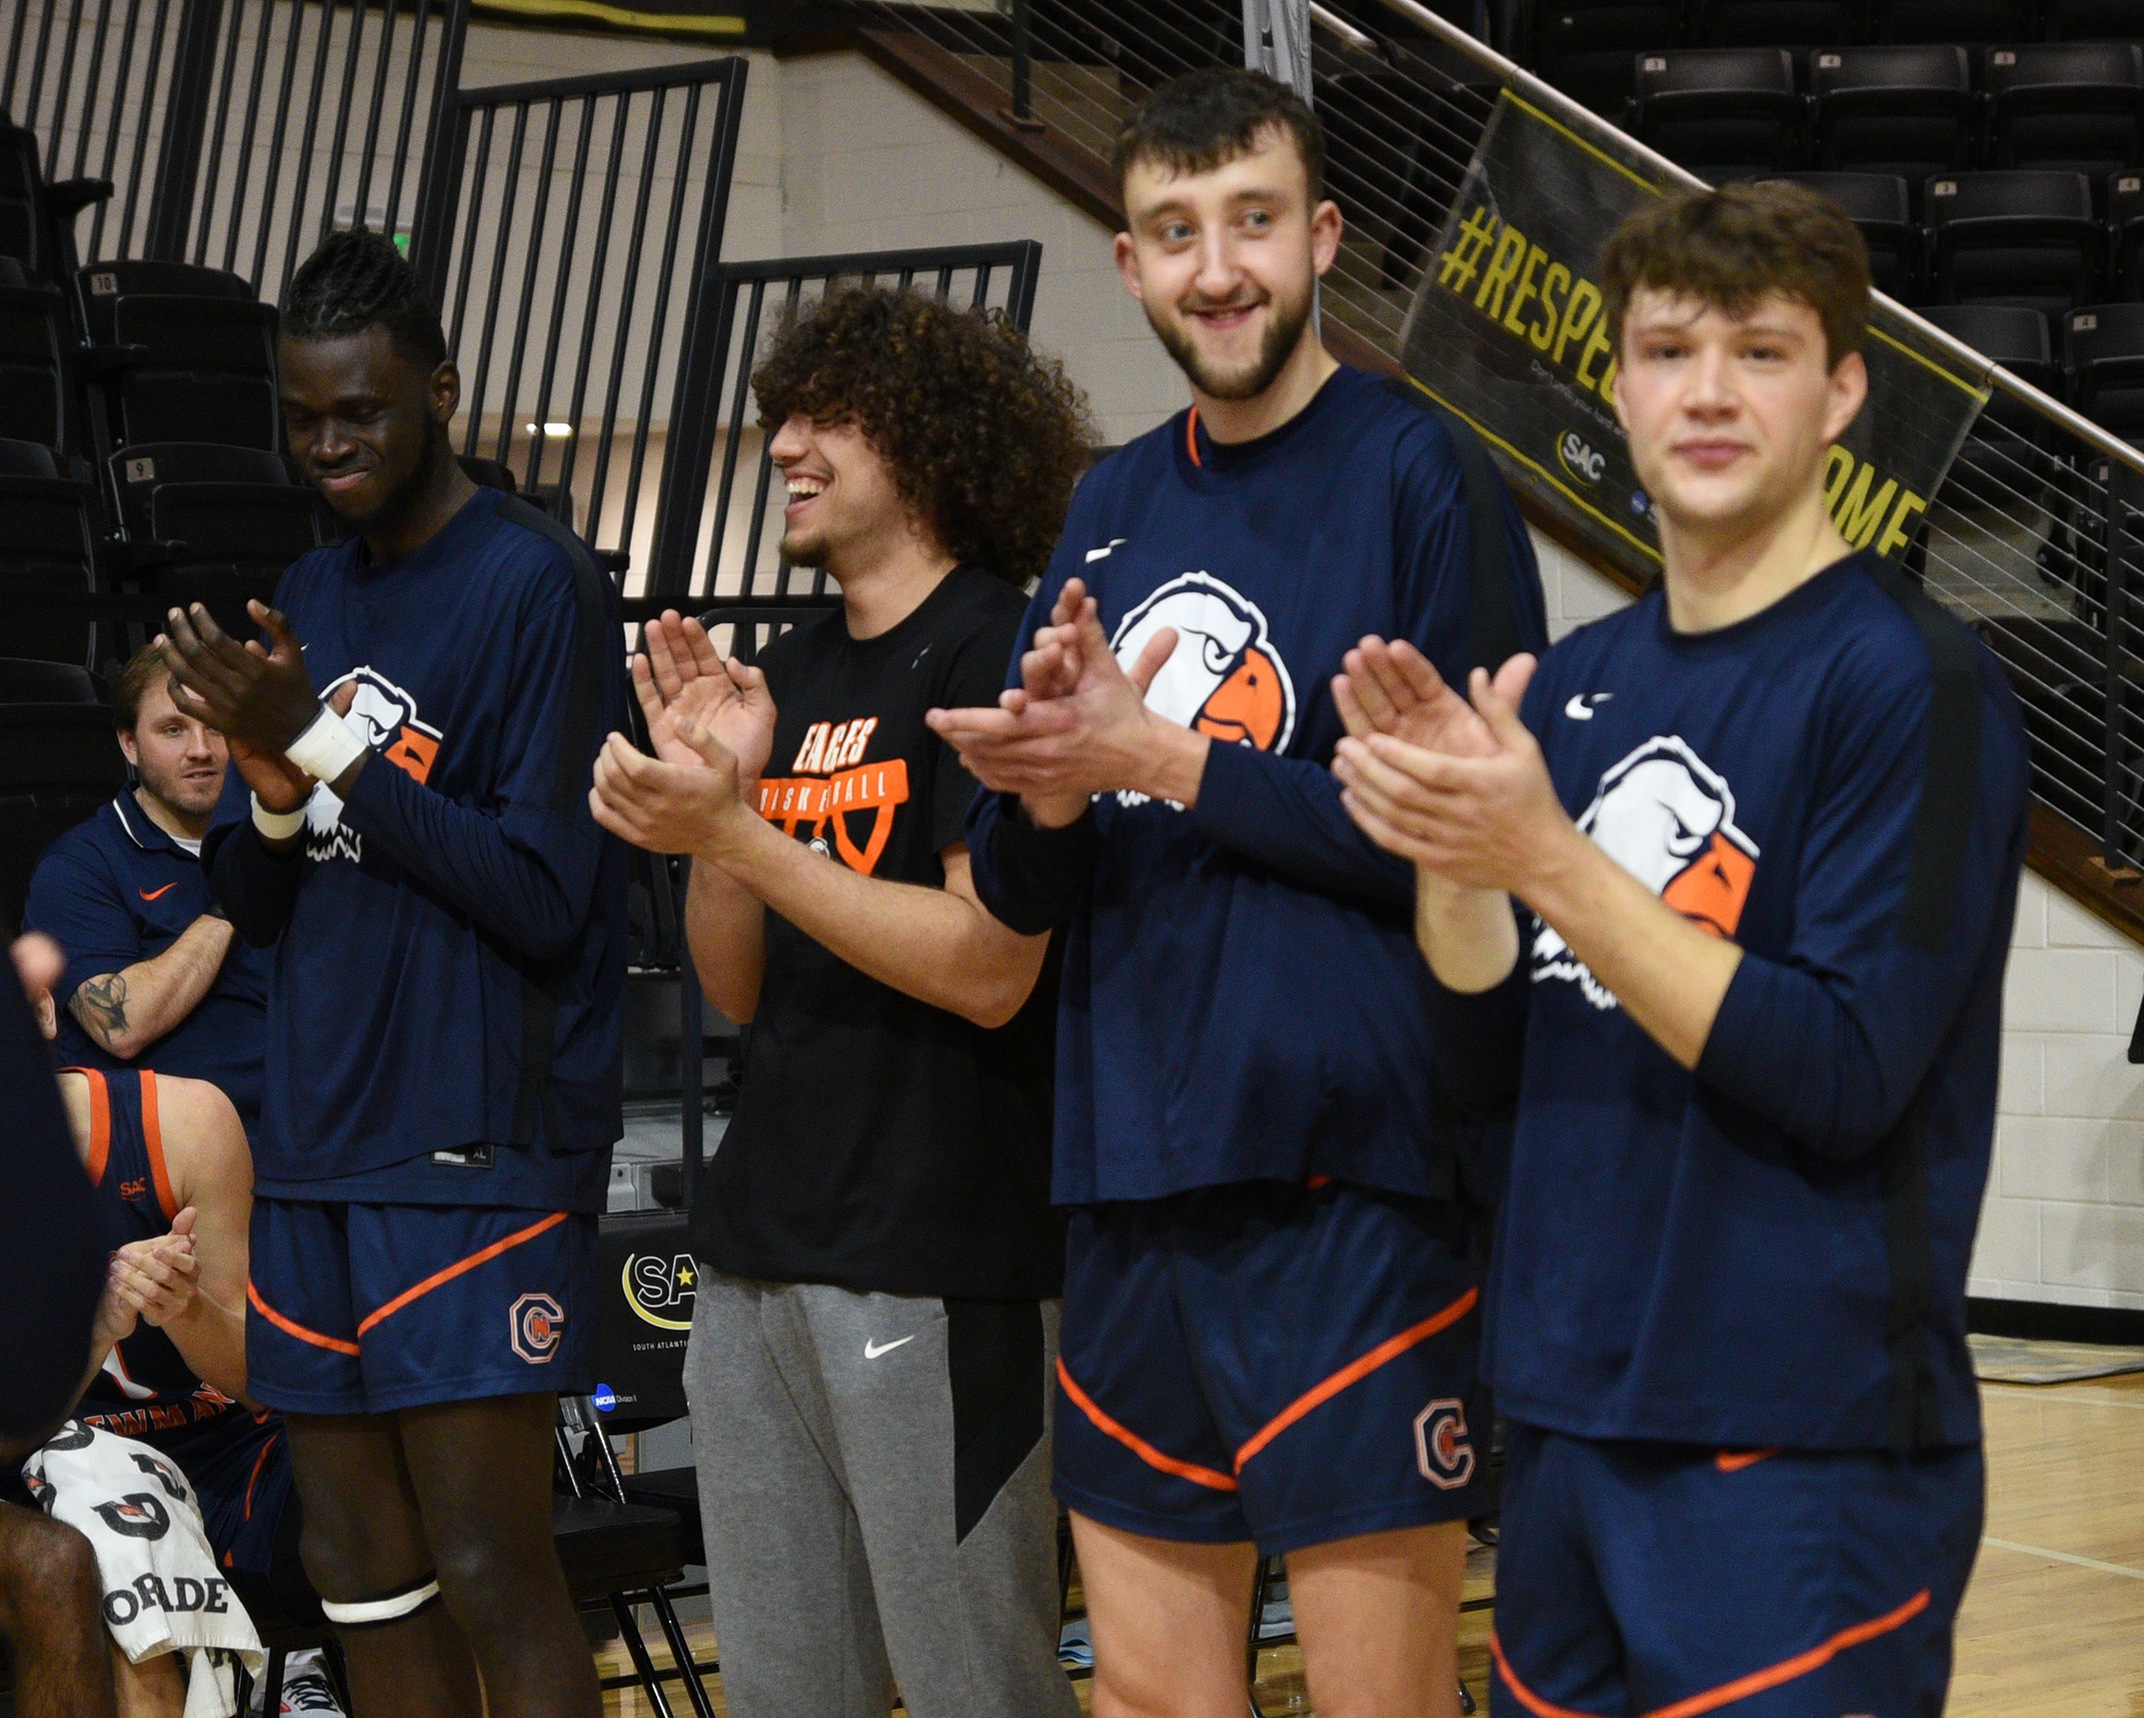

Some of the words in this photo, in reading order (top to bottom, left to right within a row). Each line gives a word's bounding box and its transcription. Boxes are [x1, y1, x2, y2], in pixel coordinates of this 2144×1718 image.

[136, 462, 144, 477] 9
[1562, 433, 1606, 480] SAC
[792, 716, 879, 774] EAGES
[120, 1176, 146, 1196] SAC
[634, 1254, 700, 1308] SA
[633, 1343, 655, 1352] SOUTH
[657, 1339, 688, 1350] ATLANTI
[84, 1382, 235, 1437] EWMAN
